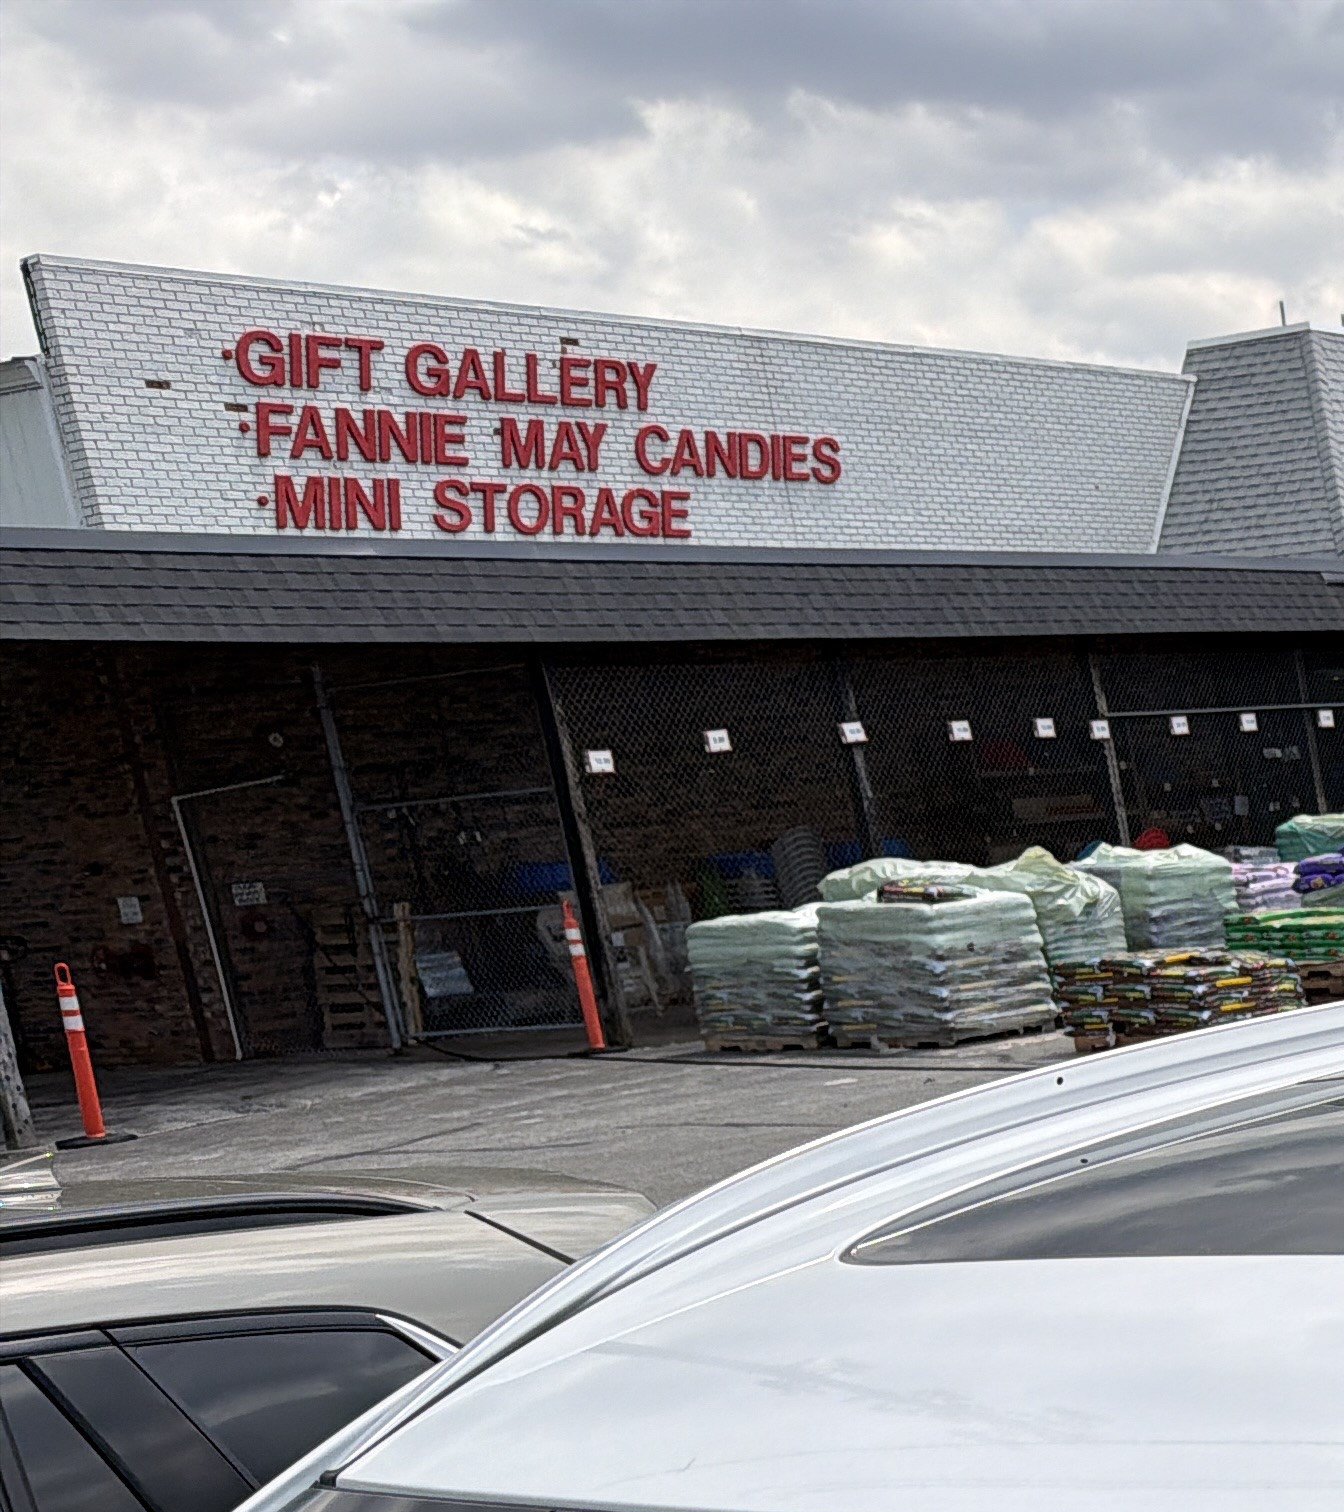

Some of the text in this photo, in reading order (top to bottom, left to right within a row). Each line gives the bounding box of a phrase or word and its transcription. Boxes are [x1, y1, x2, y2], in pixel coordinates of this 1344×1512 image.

[235, 331, 657, 411] GIFT GALLERY
[256, 402, 842, 485] FANNIE MAY CANDIES
[274, 474, 692, 538] MINI STORAGE
